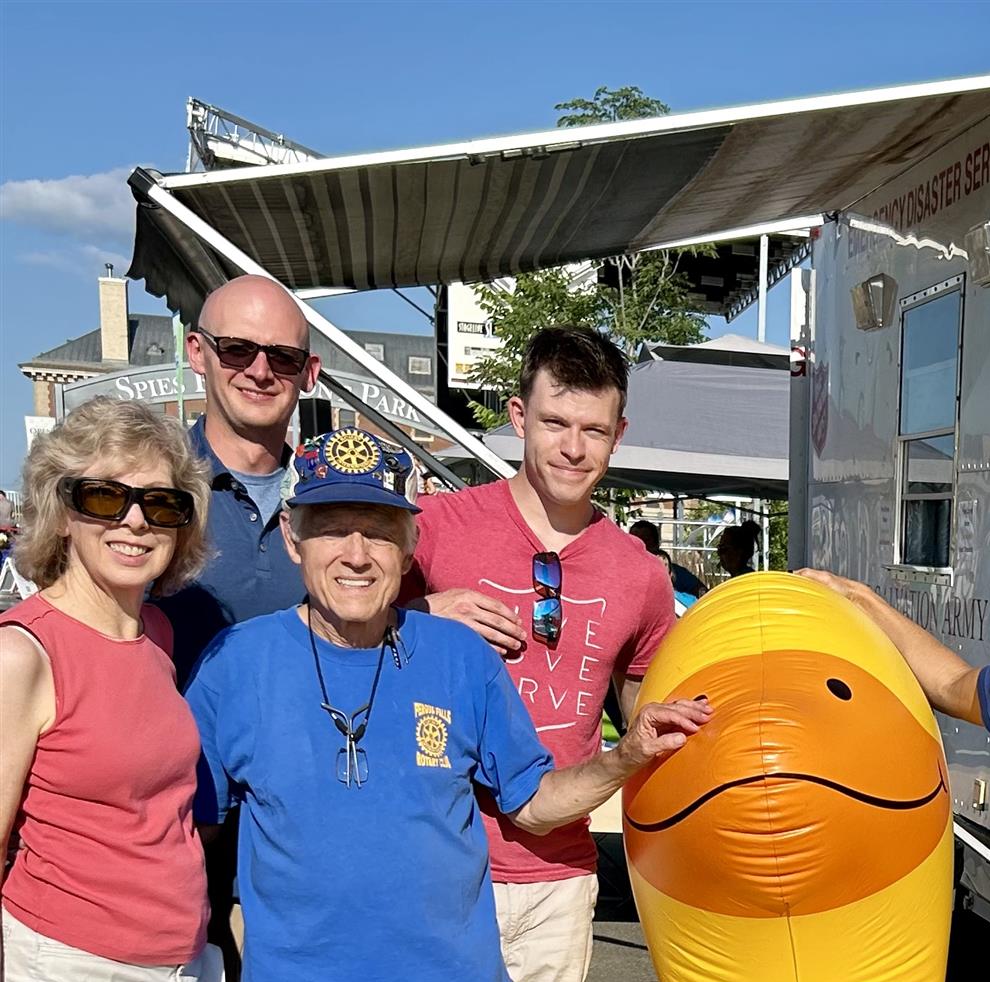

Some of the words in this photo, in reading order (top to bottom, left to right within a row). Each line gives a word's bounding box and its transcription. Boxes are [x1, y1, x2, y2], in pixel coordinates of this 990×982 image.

[906, 161, 962, 229] DISASTER
[115, 376, 187, 400] SPIES
[361, 382, 421, 423] PARK
[941, 596, 989, 642] ARMY
